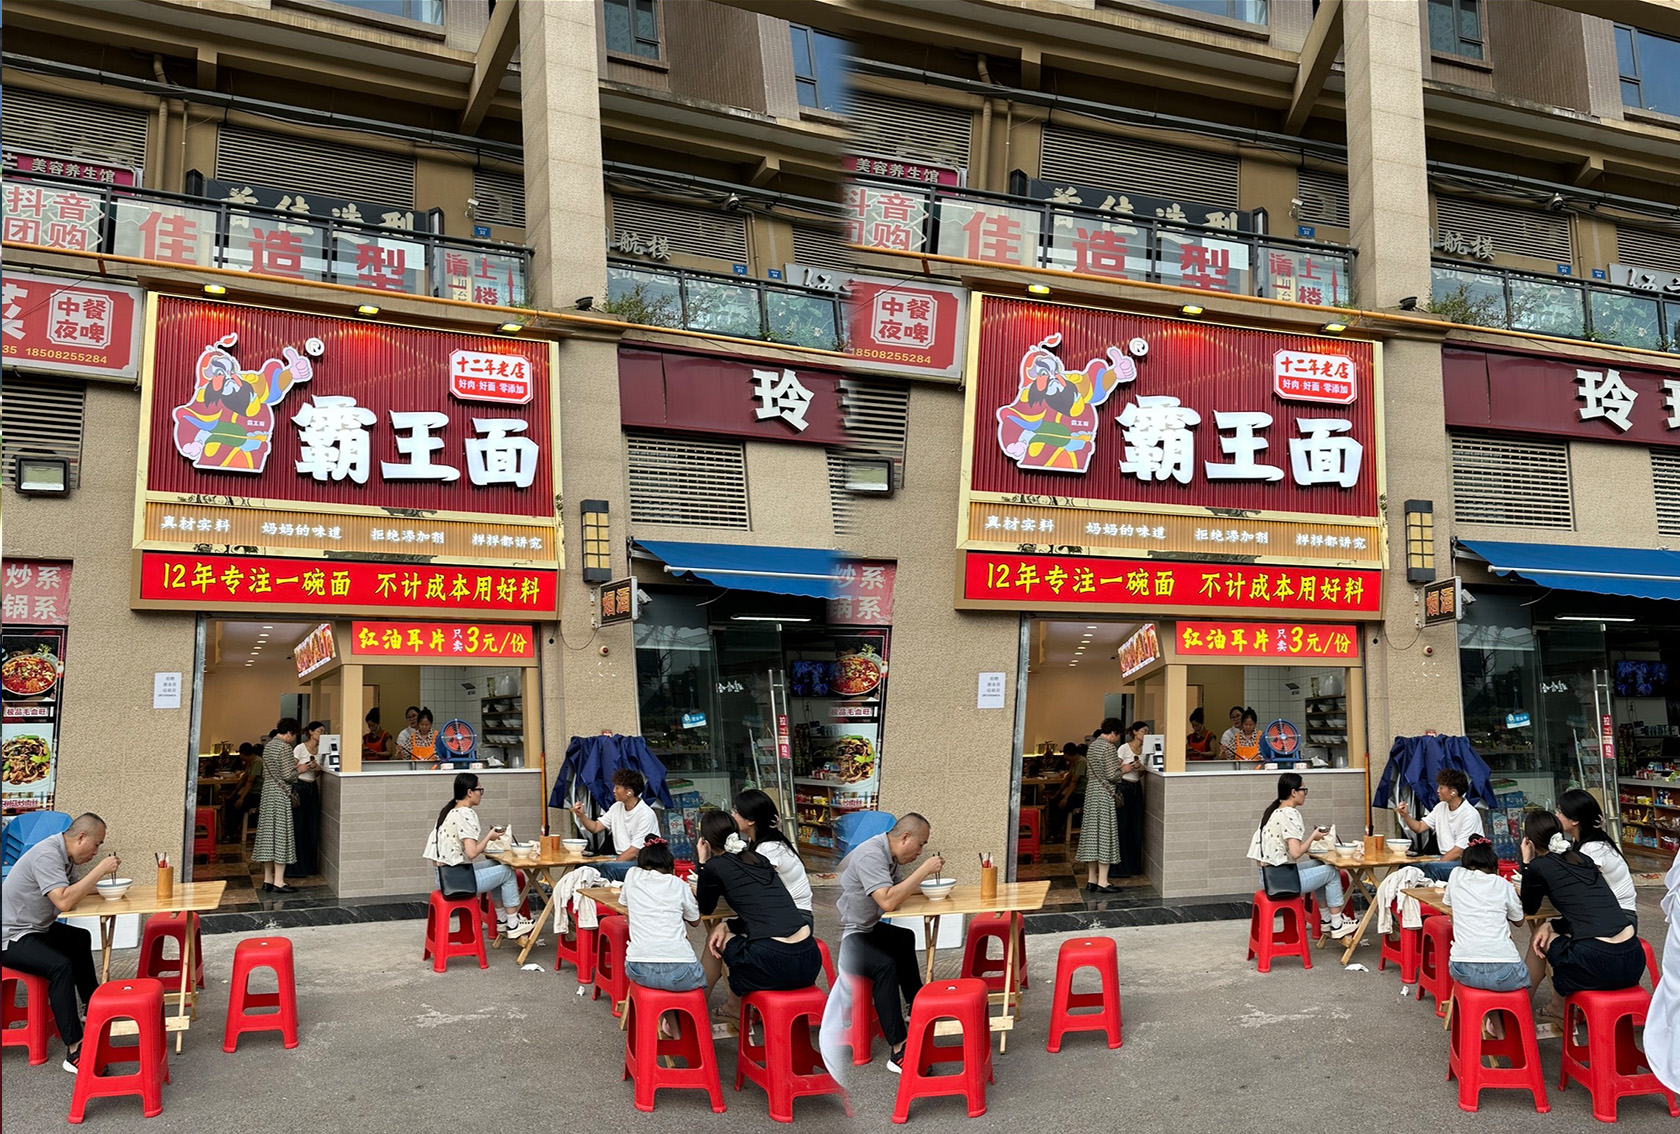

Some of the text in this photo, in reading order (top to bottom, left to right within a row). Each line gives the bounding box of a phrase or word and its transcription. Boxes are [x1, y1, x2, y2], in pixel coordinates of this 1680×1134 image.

[31, 158, 115, 183] 美容养生馆
[855, 158, 939, 183] 美容养生馆
[6, 185, 92, 222] 抖音
[3, 216, 88, 251] 团购
[605, 227, 672, 260] 航模
[1429, 227, 1496, 260] 航模
[57, 296, 107, 321] 中餐
[881, 296, 931, 321] 中餐
[54, 320, 104, 343] 夜啤
[878, 320, 928, 343] 夜啤
[25, 346, 108, 364] 18508255284
[456, 356, 525, 379] 十二年老店
[849, 346, 932, 364] 18508255284
[1280, 356, 1349, 379] 十二年老店
[291, 394, 539, 489] 霸王面
[1115, 394, 1363, 489] 霸王面
[160, 515, 543, 550] 真材实料 妈妈的味道 拒绝添加剂 样样都讲究
[984, 515, 1367, 550] 真材实料 妈妈的味道 拒绝添加剂 样样都讲究
[5, 564, 61, 590] 炒系
[162, 561, 541, 605] 12年专注一碗面 不计成本用好料
[986, 561, 1365, 605] 12年专注一碗面 不计成本用好料
[2, 594, 58, 620] 锅系
[358, 627, 445, 653] 红油耳片
[1182, 627, 1269, 653] 红油耳片
